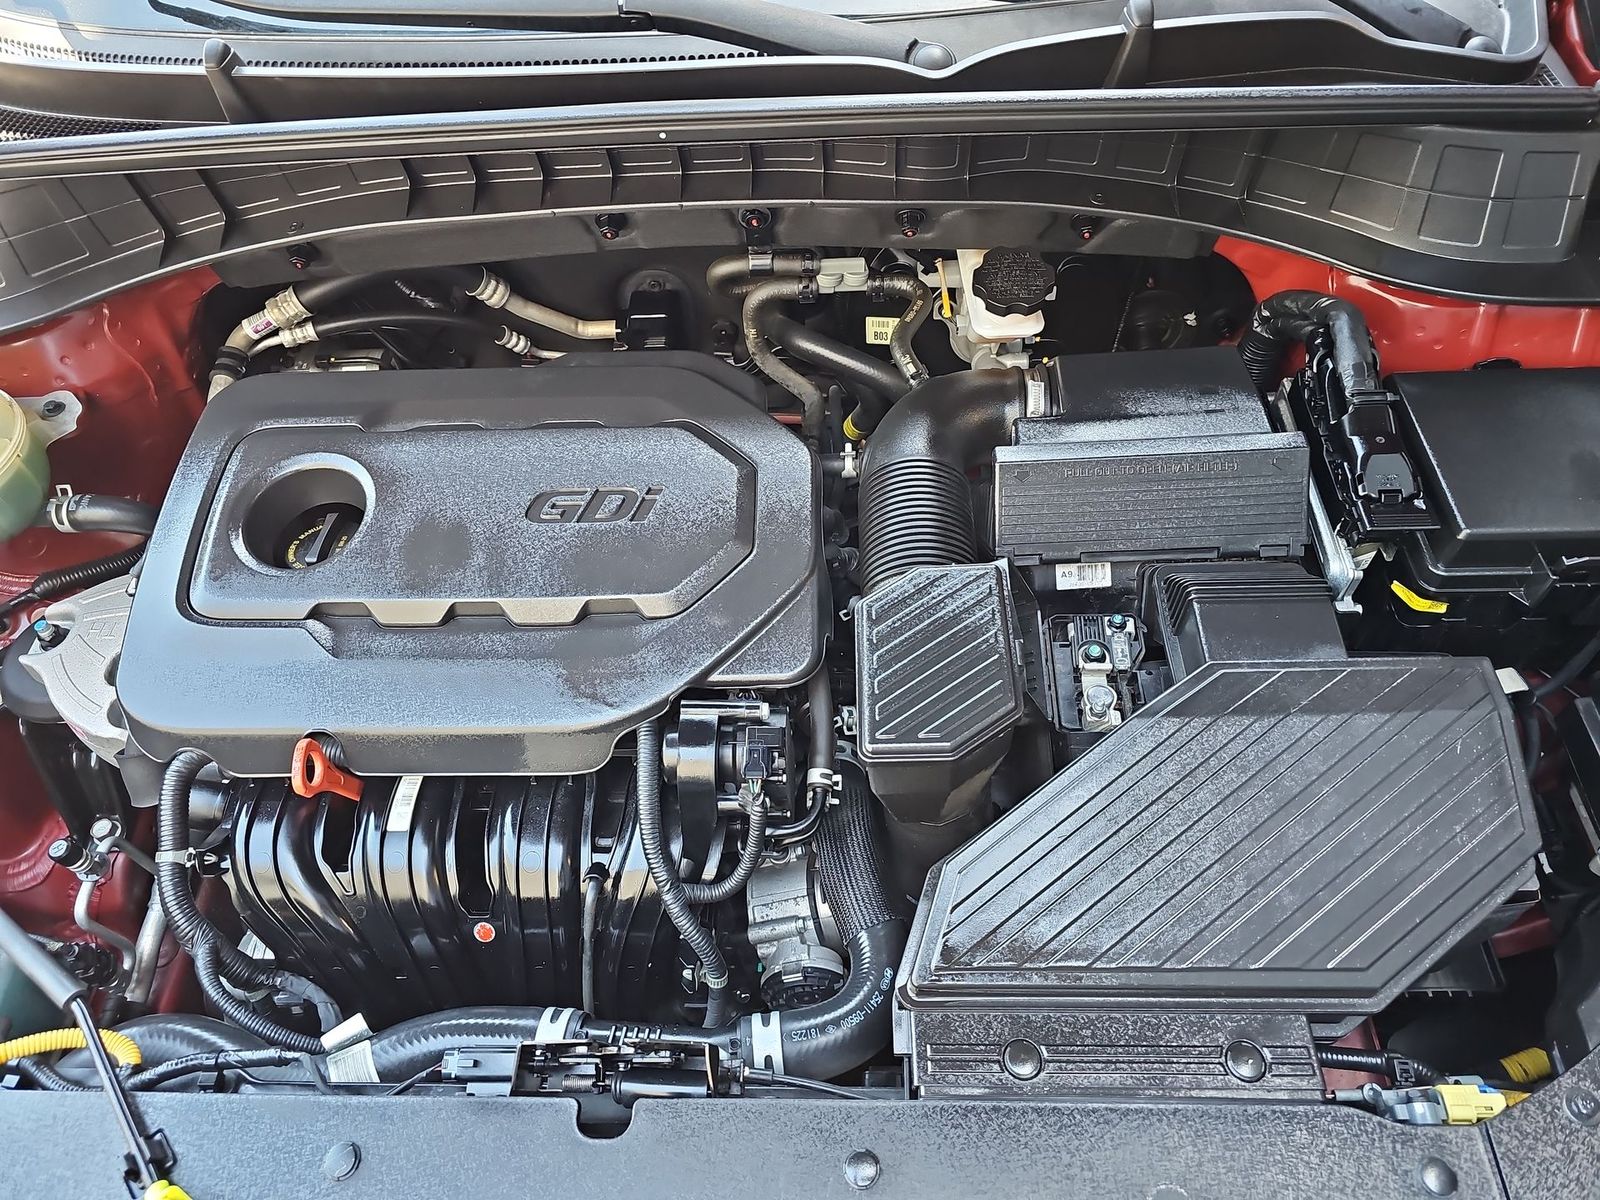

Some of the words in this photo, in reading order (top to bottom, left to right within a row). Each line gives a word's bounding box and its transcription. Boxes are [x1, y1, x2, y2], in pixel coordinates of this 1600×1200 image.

[873, 331, 889, 341] B03
[1064, 467, 1092, 478] PULL
[1095, 467, 1118, 476] OUT
[1120, 465, 1134, 475] TO
[525, 486, 665, 523] GDi
[299, 525, 323, 539] MANUA
[791, 1027, 821, 1042] 181225
